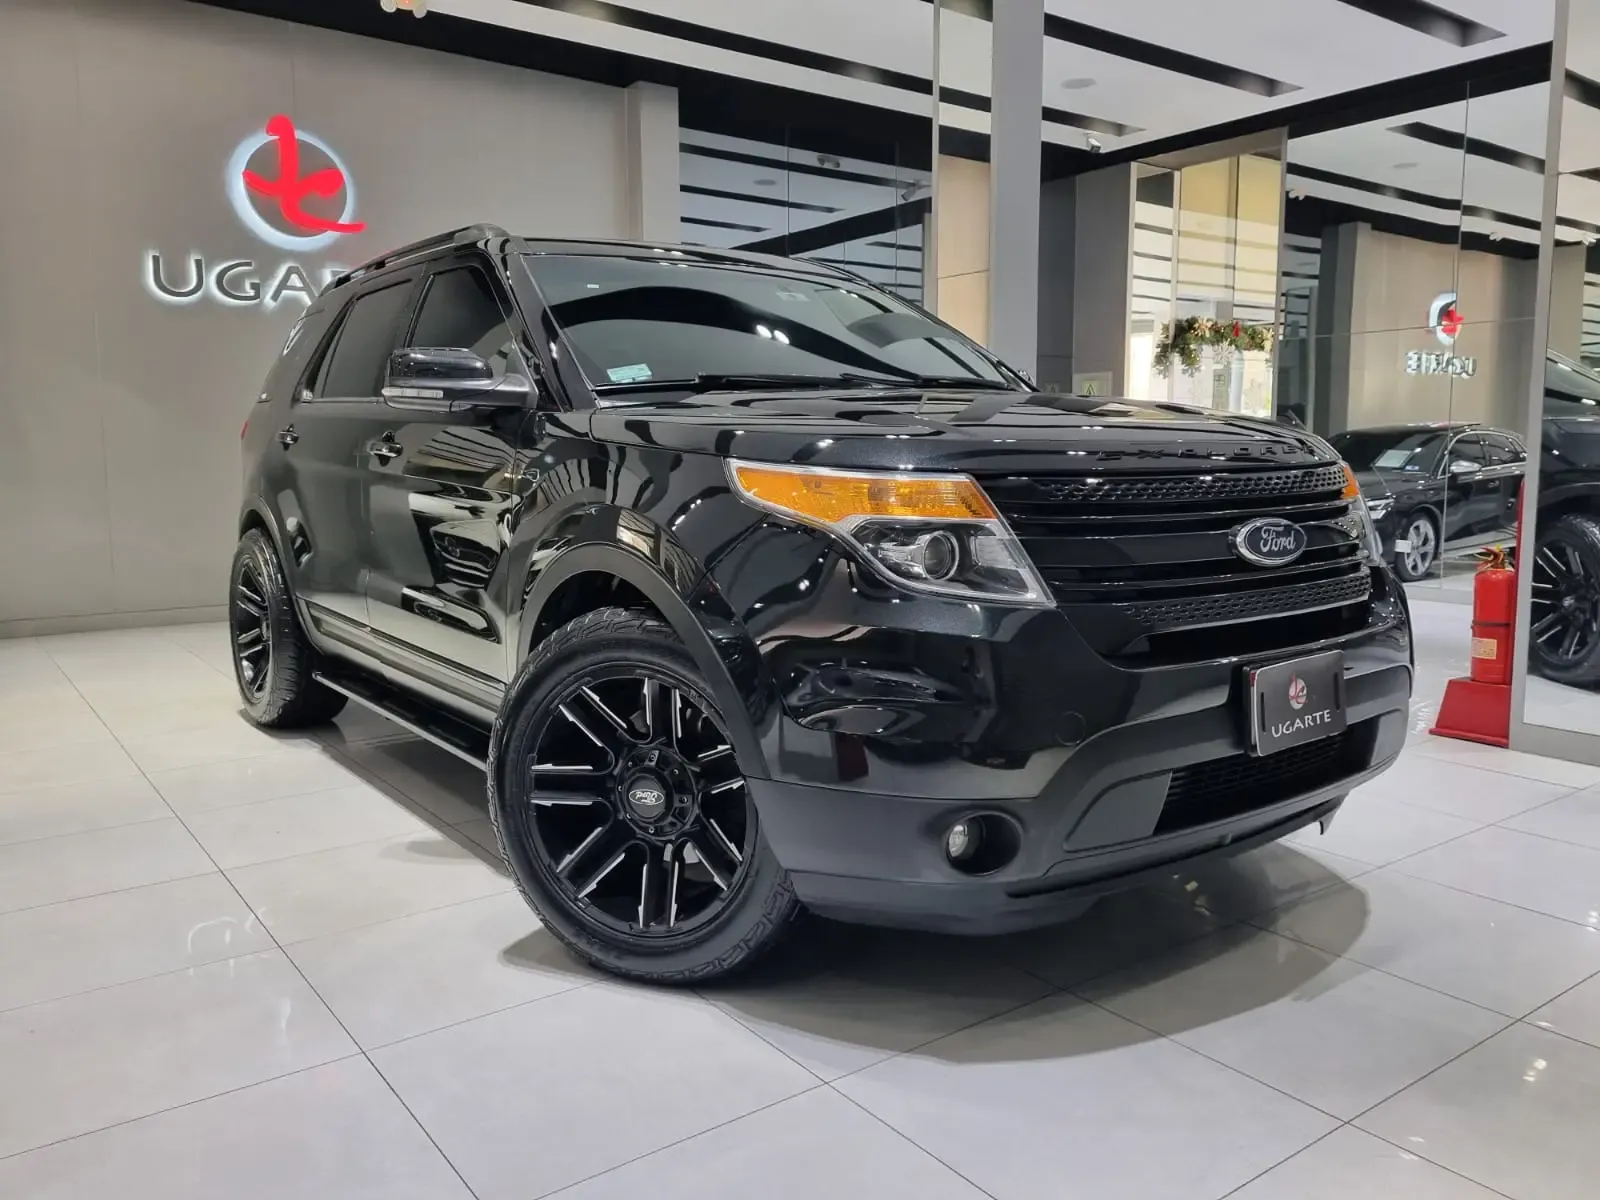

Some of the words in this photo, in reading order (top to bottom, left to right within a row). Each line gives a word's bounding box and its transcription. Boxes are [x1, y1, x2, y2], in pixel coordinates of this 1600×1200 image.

[148, 251, 350, 306] UGA
[1260, 526, 1296, 552] Ford
[1271, 709, 1332, 738] UGARTE
